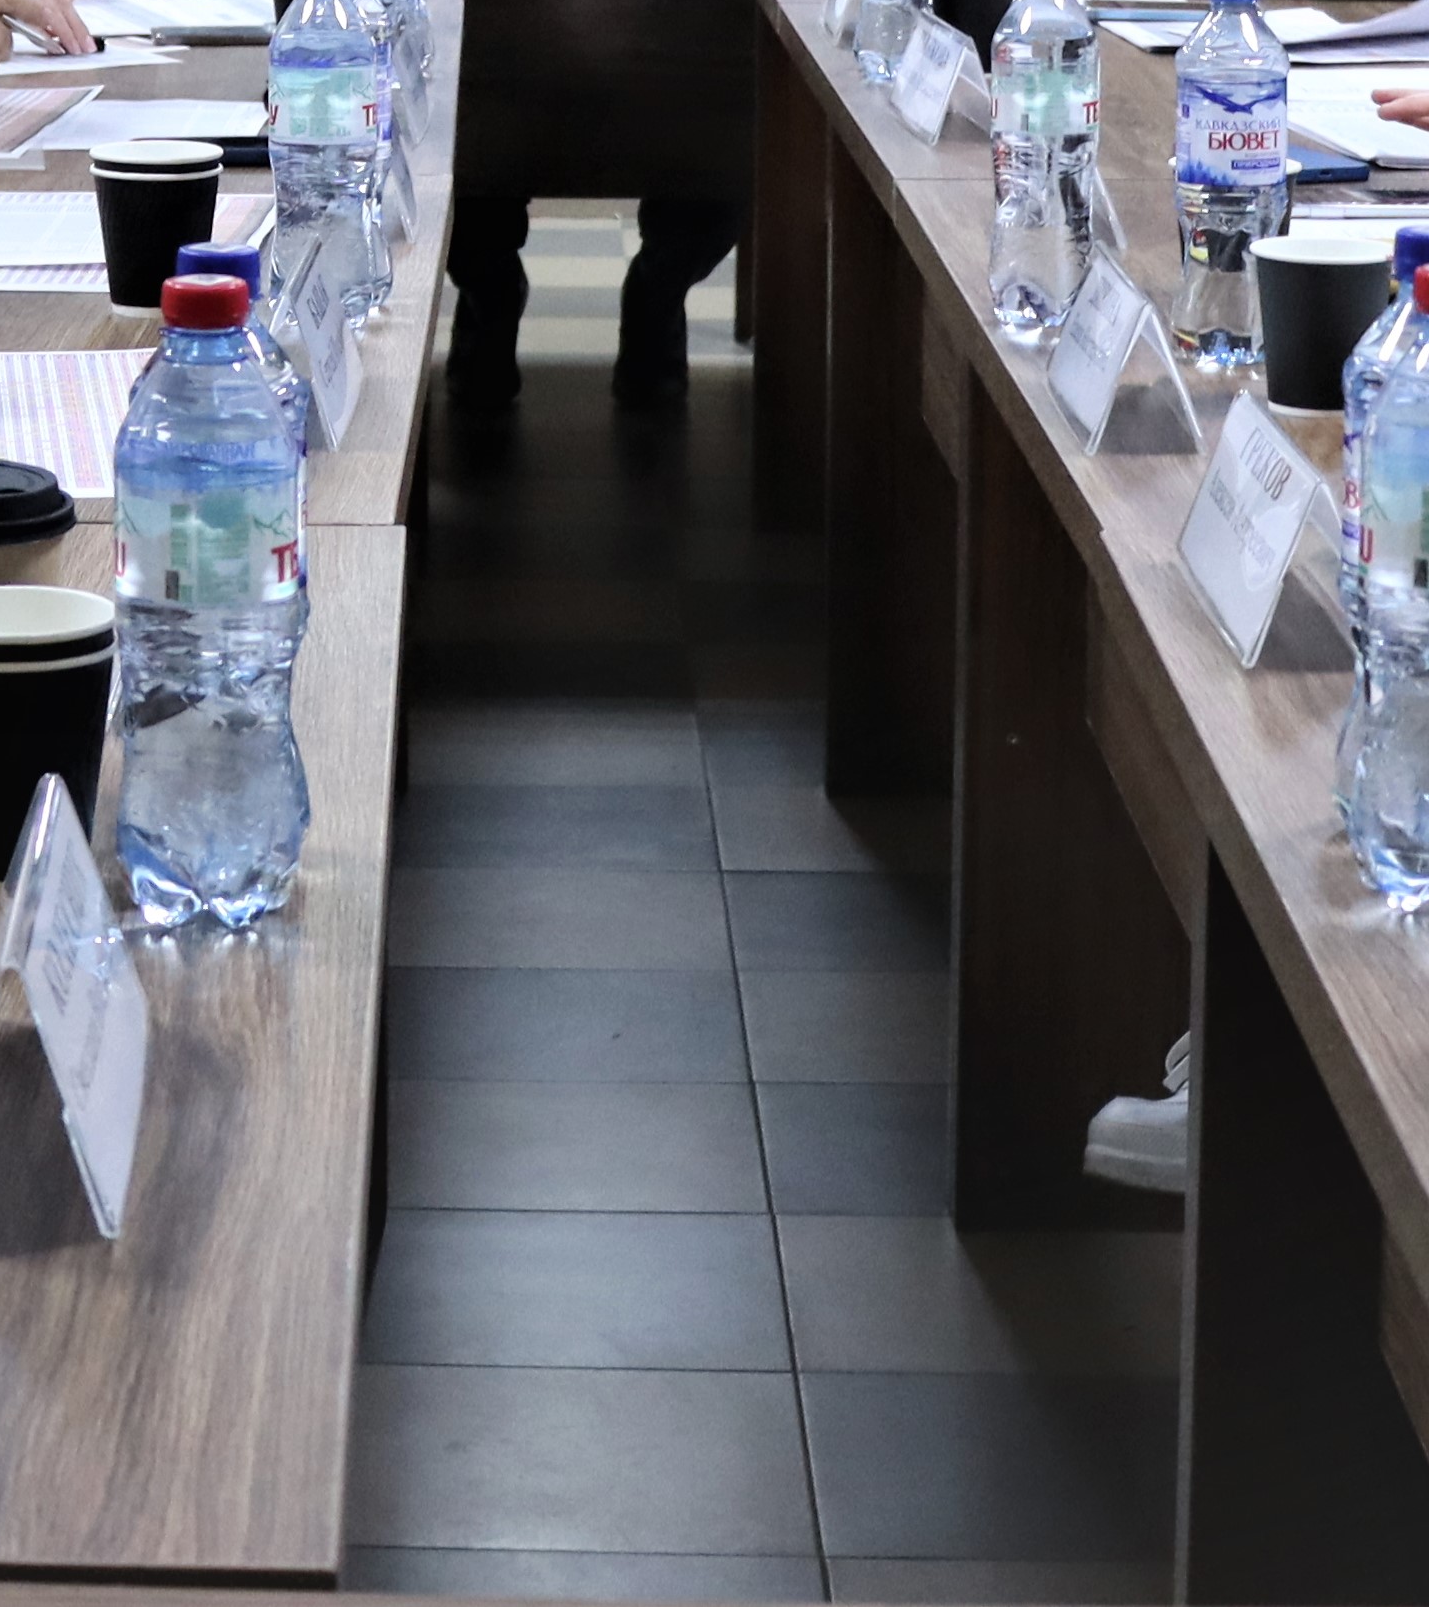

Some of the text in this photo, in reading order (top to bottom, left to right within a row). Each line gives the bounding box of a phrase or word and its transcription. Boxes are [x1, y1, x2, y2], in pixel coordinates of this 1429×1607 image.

[1194, 117, 1281, 132] КАВКАЗСКИЙ
[1208, 130, 1279, 151] БЮВЕТ
[1240, 427, 1291, 501] ГРЕКОВ
